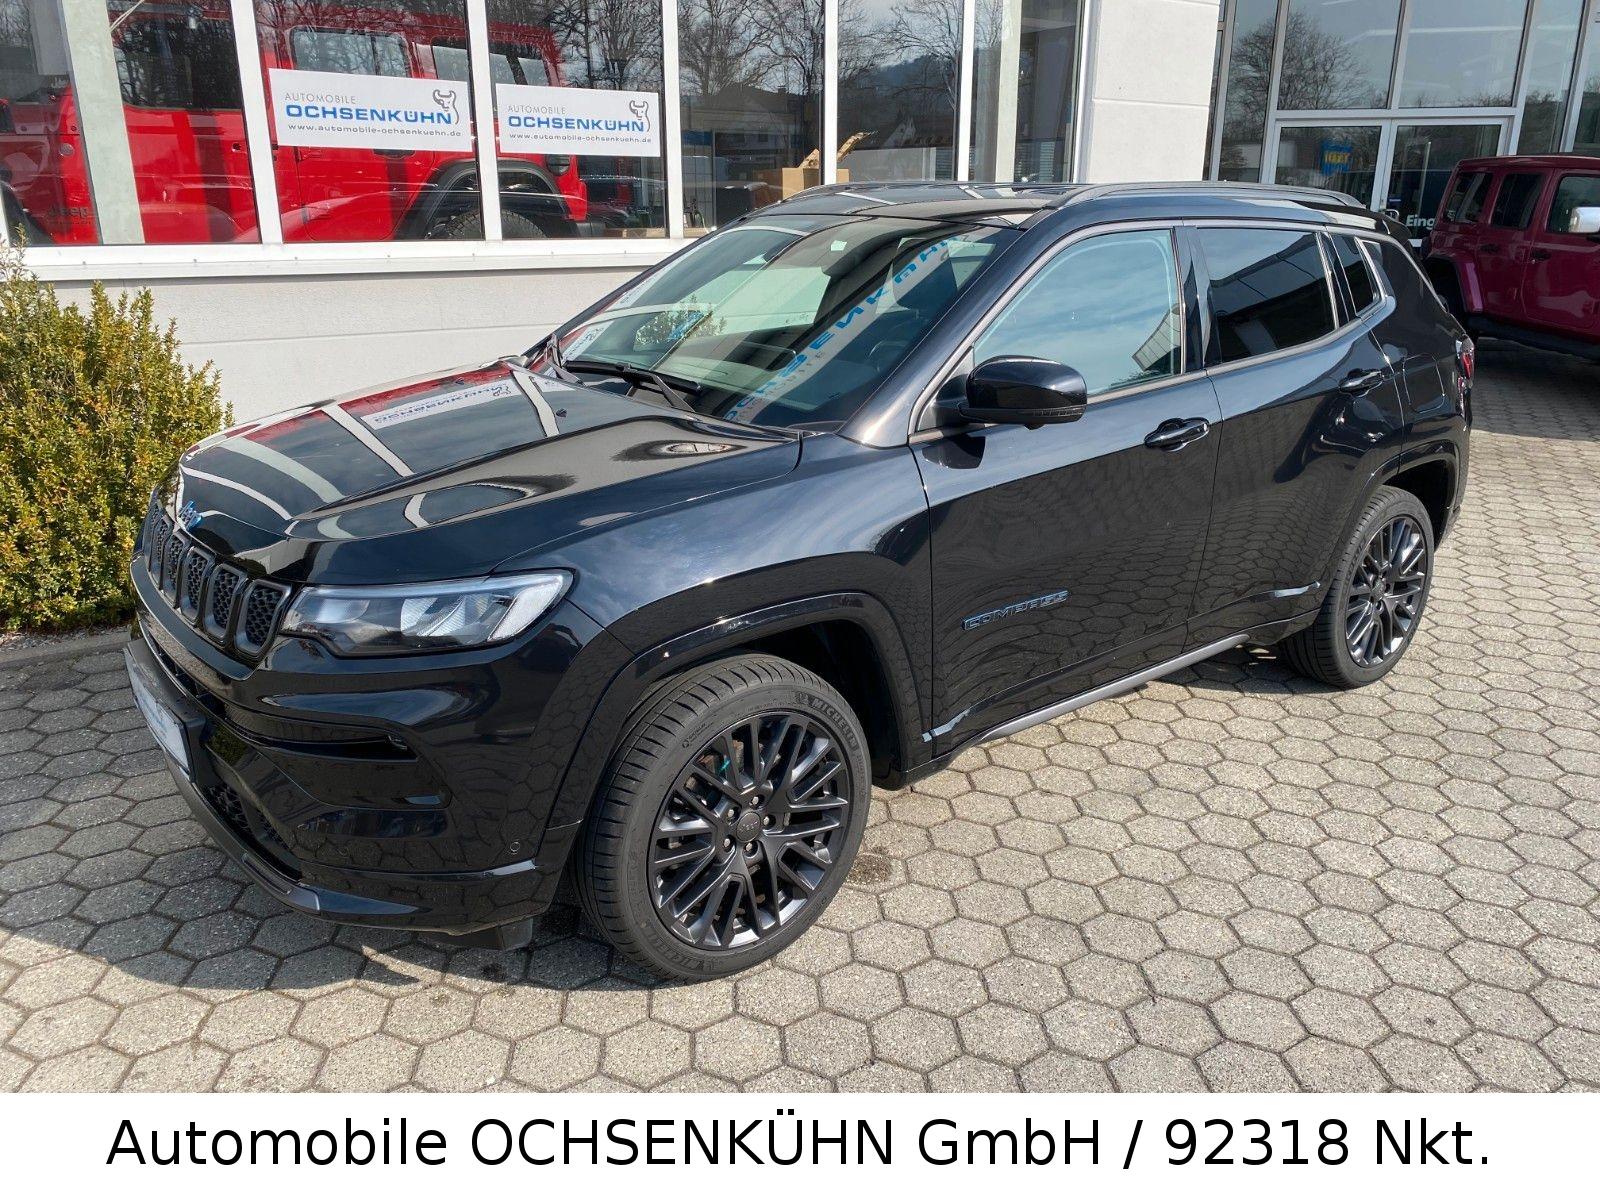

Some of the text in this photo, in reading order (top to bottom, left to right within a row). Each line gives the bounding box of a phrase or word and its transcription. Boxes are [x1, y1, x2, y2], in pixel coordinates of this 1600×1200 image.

[284, 92, 356, 105] AUTOMOBILE
[285, 104, 453, 125] OCHSENKÜHN
[507, 105, 567, 115] AUTOMOBILE
[287, 123, 463, 138] www.automobile-ochsenkuehn.de
[508, 115, 645, 132] OCHSENKÜHN
[508, 133, 652, 144] www.automobile-ochsenkuehn.de
